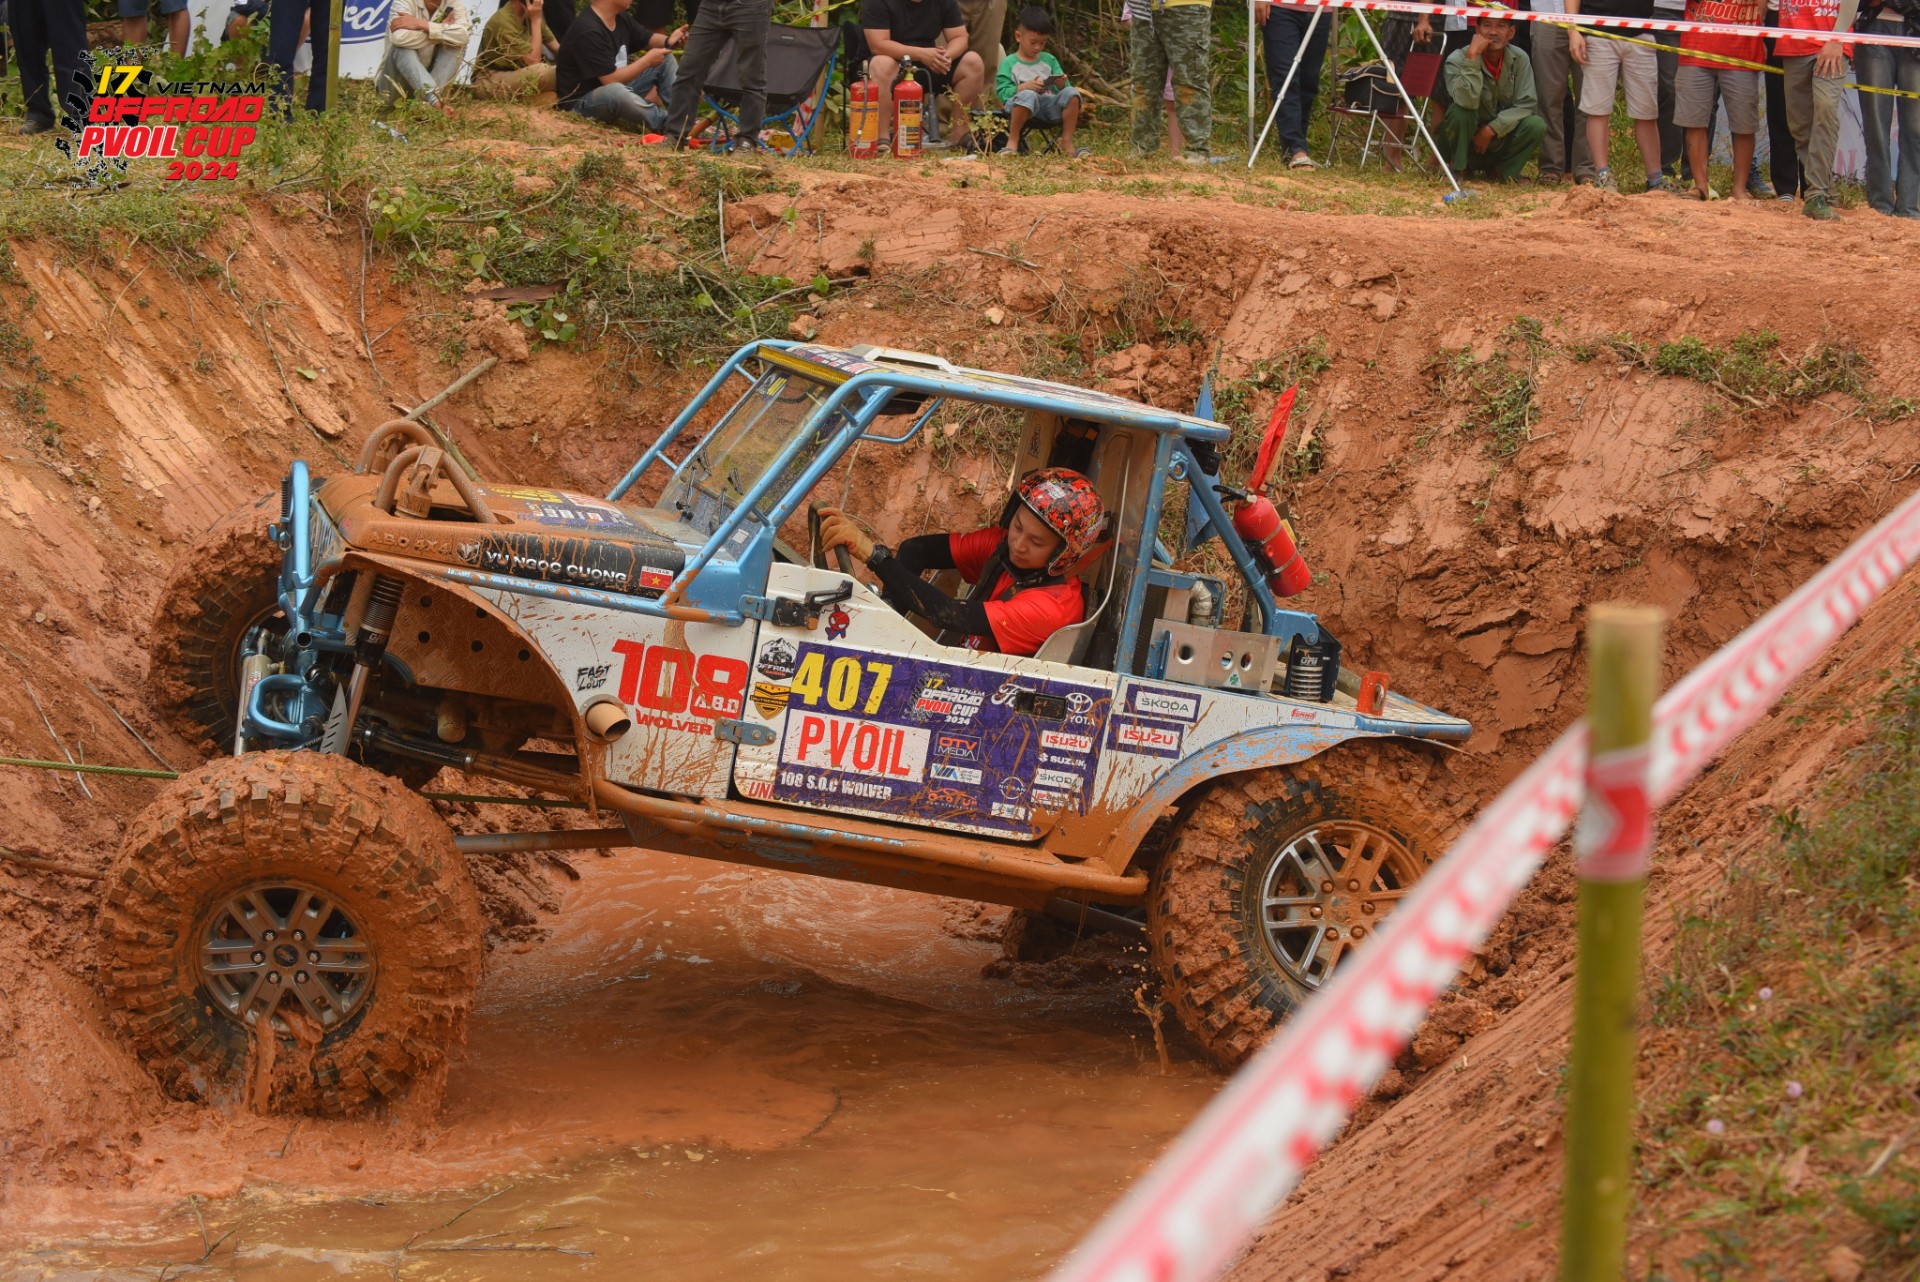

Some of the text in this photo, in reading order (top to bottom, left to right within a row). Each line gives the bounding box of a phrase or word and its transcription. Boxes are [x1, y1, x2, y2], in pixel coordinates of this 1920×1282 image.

[566, 564, 627, 584] CUONG
[612, 638, 749, 720] 108
[790, 651, 893, 715] 407
[926, 677, 985, 697] 17 VIETNAM
[921, 688, 984, 706] OFFROAD
[951, 703, 979, 717] CUP
[636, 709, 713, 736] WOLVER
[944, 715, 971, 726] 2024
[797, 716, 911, 777] PVOIL
[1045, 734, 1089, 749] ISUZU
[1124, 730, 1174, 746] ISUZU
[937, 746, 976, 761] MEDIA
[780, 772, 892, 800] 108 S.O.C WOLVER
